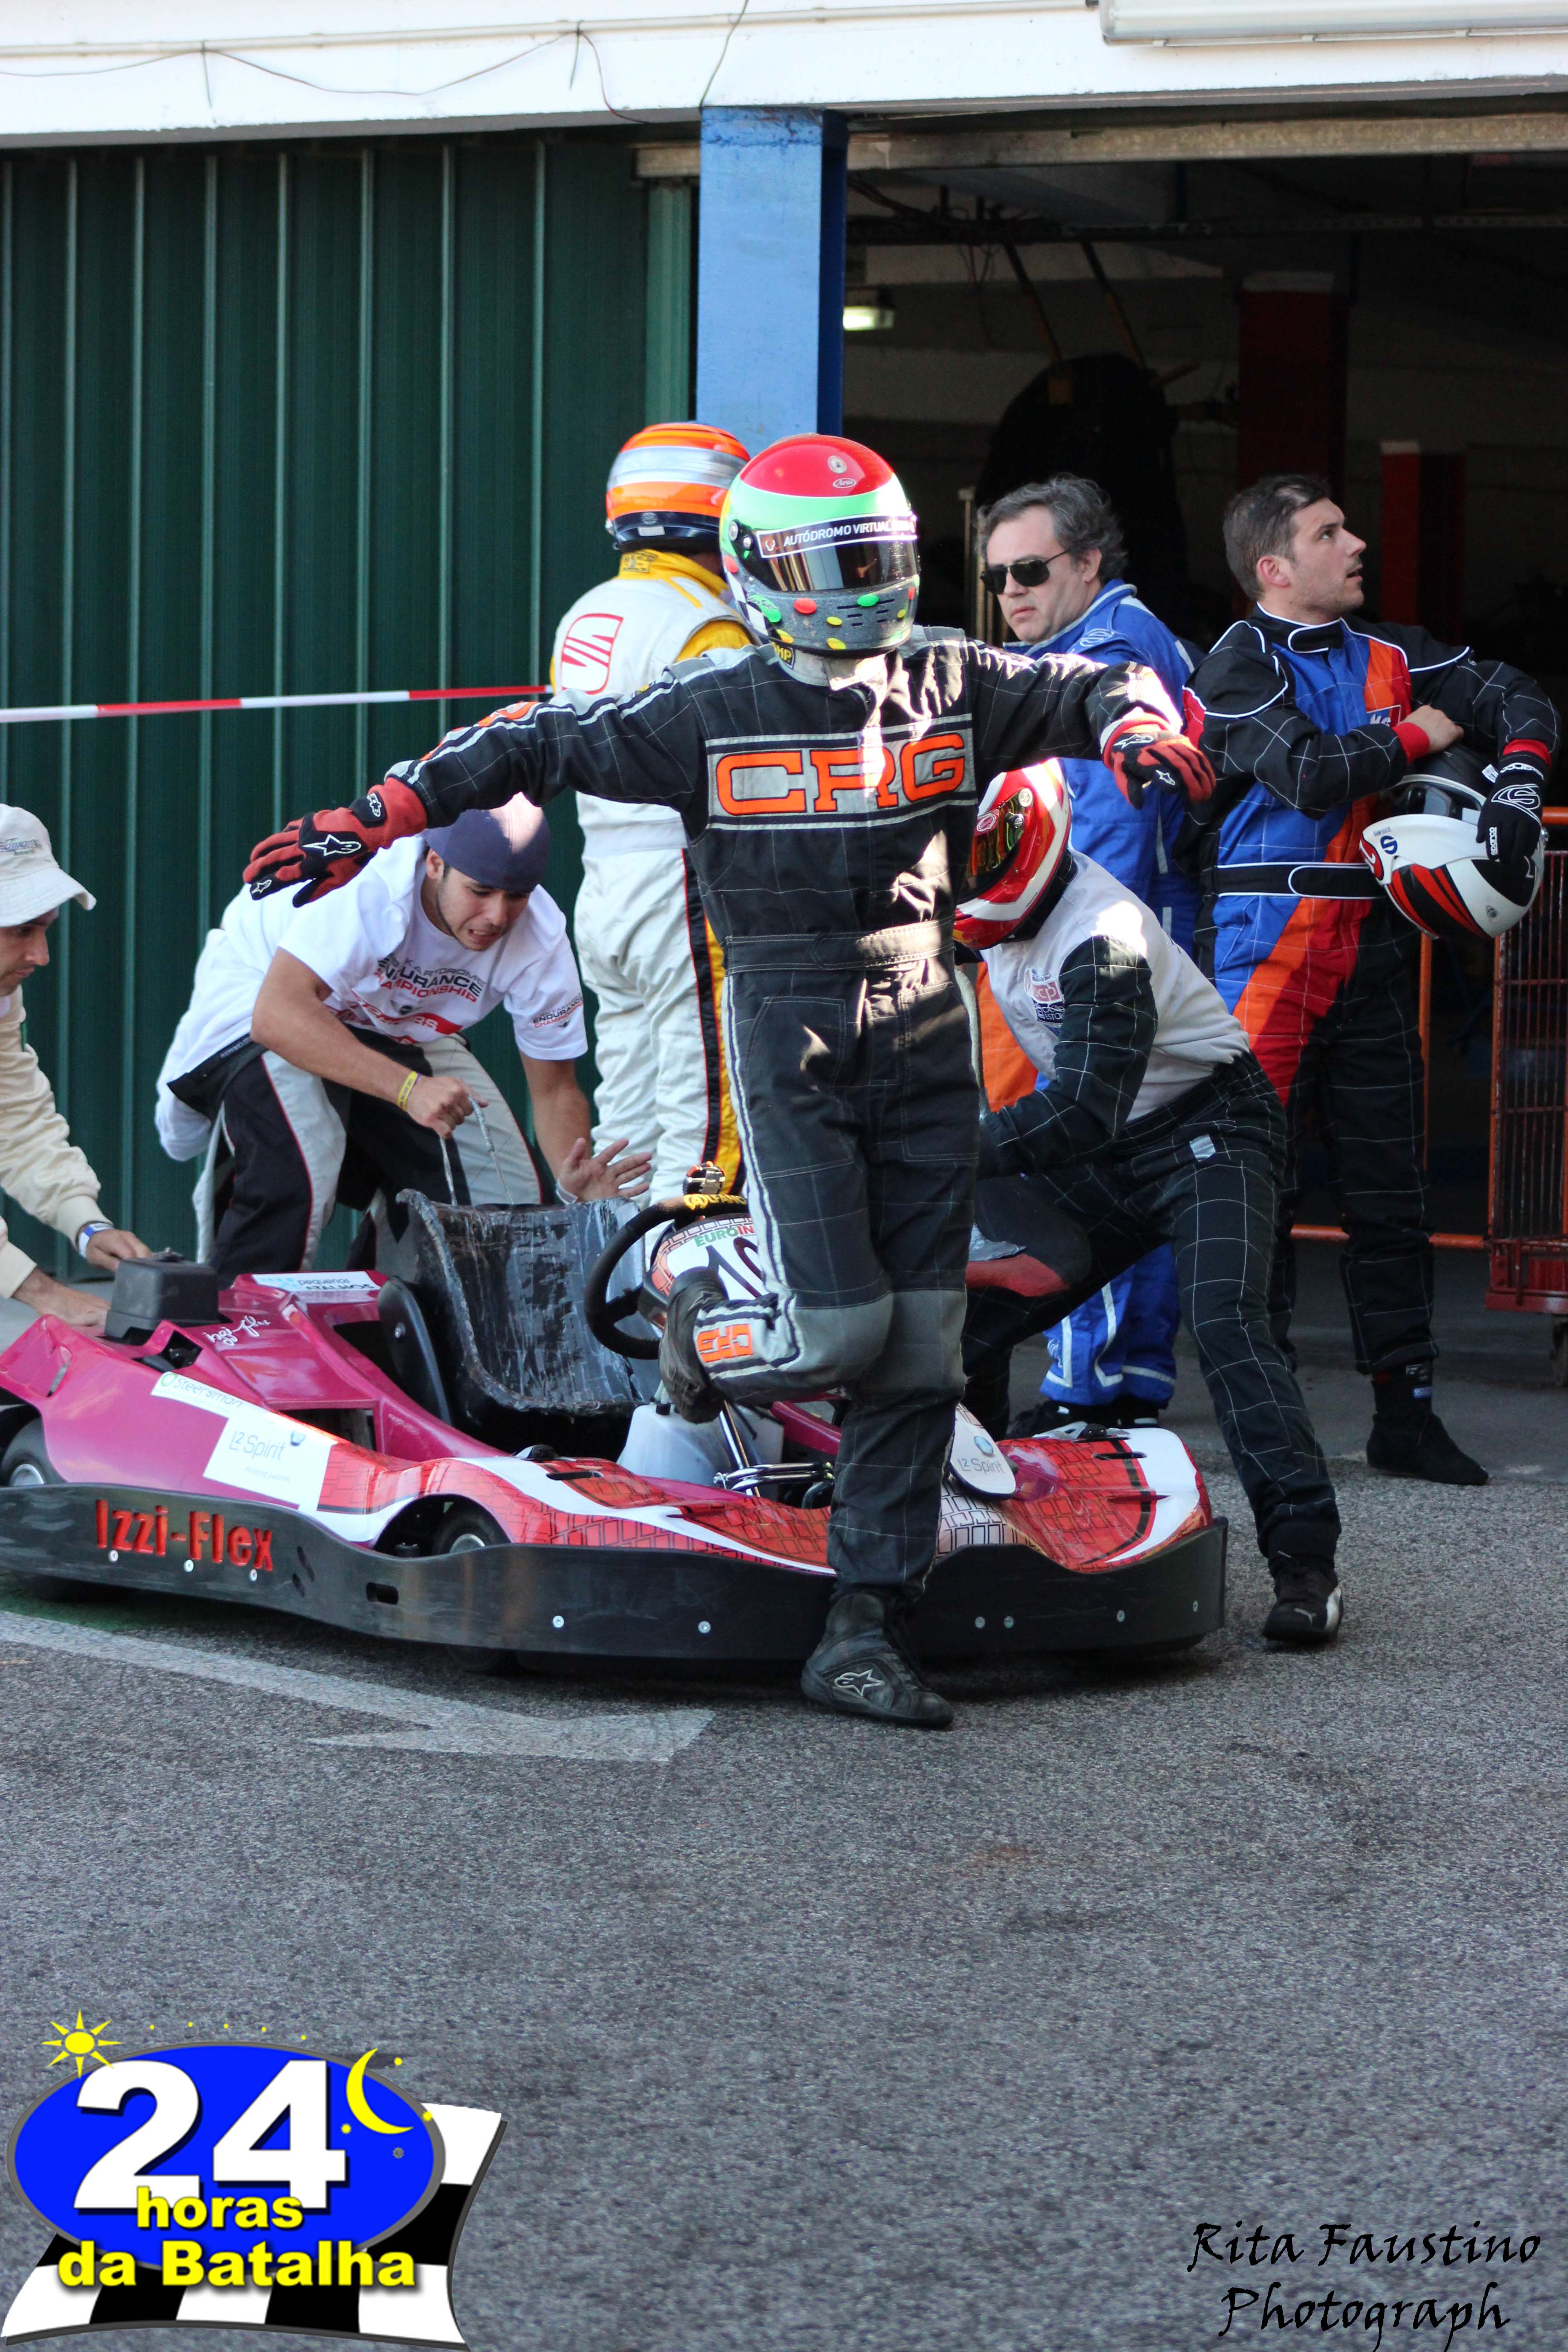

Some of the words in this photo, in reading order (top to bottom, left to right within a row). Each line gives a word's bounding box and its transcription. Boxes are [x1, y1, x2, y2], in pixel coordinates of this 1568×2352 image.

[784, 525, 852, 547] AUTÓDROMO
[853, 521, 891, 534] VIRTUAL
[772, 642, 792, 661] MP
[716, 733, 965, 816] CRG
[375, 968, 478, 1002] AMPIONSHIP
[377, 953, 482, 997] ENURANCE
[244, 1434, 287, 1461] Spirit
[970, 1458, 1005, 1475] Spirit
[96, 1499, 273, 1572] Izzi-Flex
